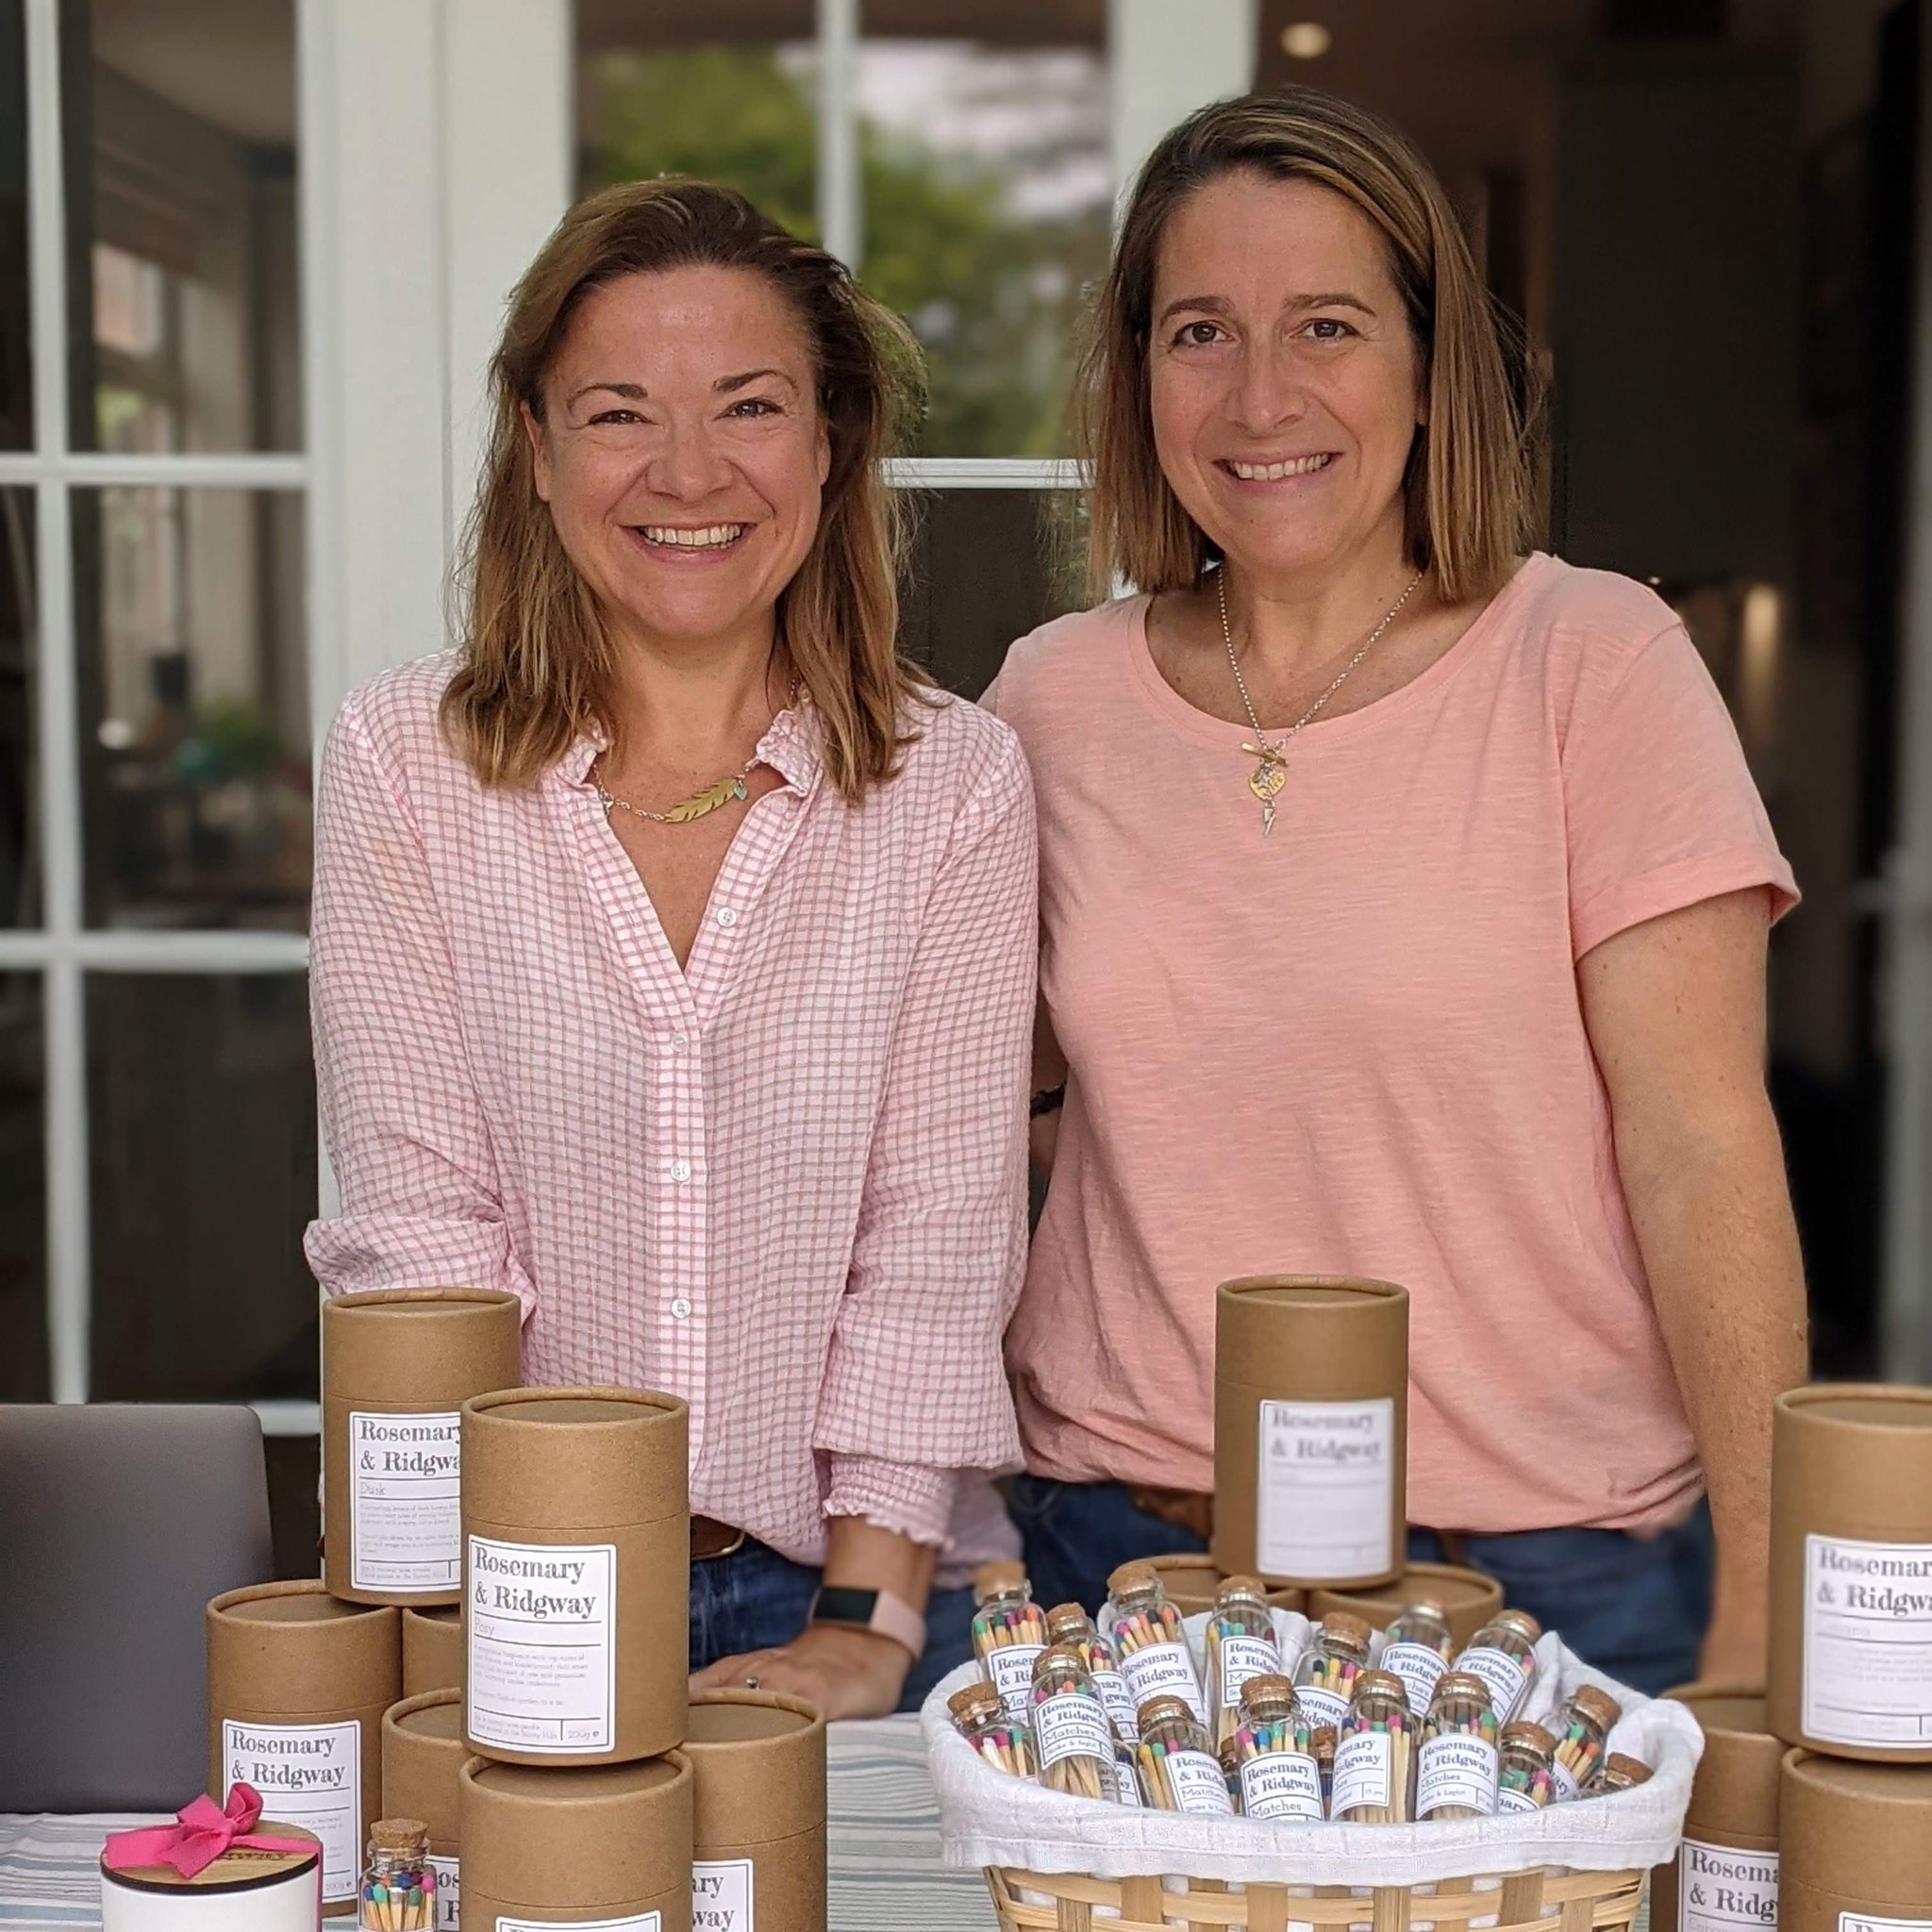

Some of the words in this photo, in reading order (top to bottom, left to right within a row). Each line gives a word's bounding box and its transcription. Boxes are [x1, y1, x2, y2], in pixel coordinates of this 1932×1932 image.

[360, 1450, 375, 1471] &
[475, 1545, 586, 1586] Rosemary
[1819, 1546, 1932, 1578] Rosemar
[475, 1581, 488, 1605] &
[493, 1585, 597, 1620] Ridgway
[1817, 1581, 1835, 1604] &
[1229, 1656, 1240, 1666] &
[1000, 1674, 1009, 1687] &
[1137, 1669, 1189, 1689] Ridgway
[1041, 1701, 1104, 1719] Rosemary
[1043, 1717, 1052, 1728] &
[230, 1729, 336, 1757] Rosemary
[1044, 1726, 1095, 1745] Matches
[1424, 1740, 1489, 1760] Rosemary
[232, 1759, 245, 1780] &
[252, 1762, 345, 1790] Ridgway
[1246, 1763, 1309, 1782] Rosemary
[1436, 1753, 1491, 1777] Ridgway
[1179, 1772, 1191, 1781] &
[1262, 1775, 1316, 1795] Ridgway
[1251, 1799, 1302, 1818] Matches
[1690, 1883, 1706, 1906] &
[1716, 1888, 1776, 1923] Ridg
